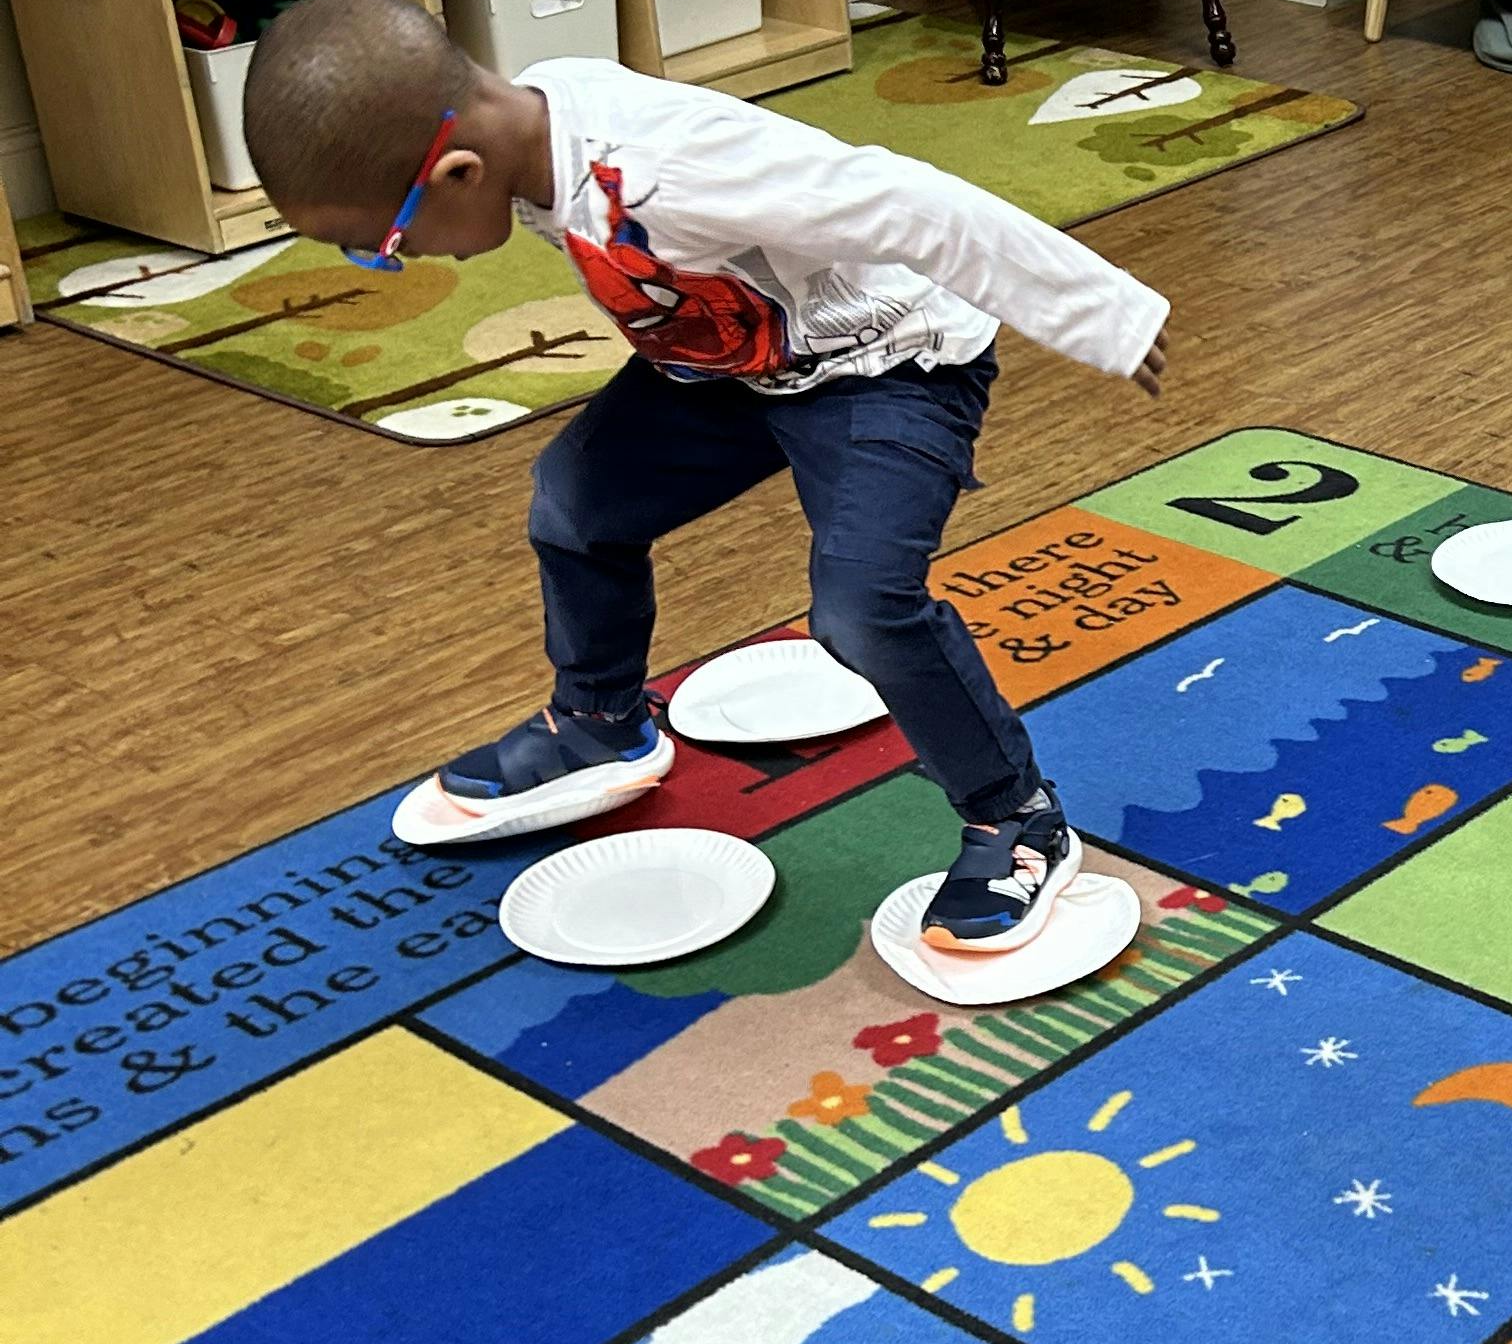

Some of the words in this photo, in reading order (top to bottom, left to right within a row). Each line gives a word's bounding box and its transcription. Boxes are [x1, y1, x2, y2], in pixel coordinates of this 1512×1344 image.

[1165, 460, 1360, 536] 2
[941, 528, 1106, 600] there
[1000, 547, 1160, 621] night
[999, 632, 1073, 664] &
[1073, 576, 1183, 633] day
[328, 863, 475, 931] the
[120, 1042, 217, 1095] &
[223, 963, 382, 1039] the
